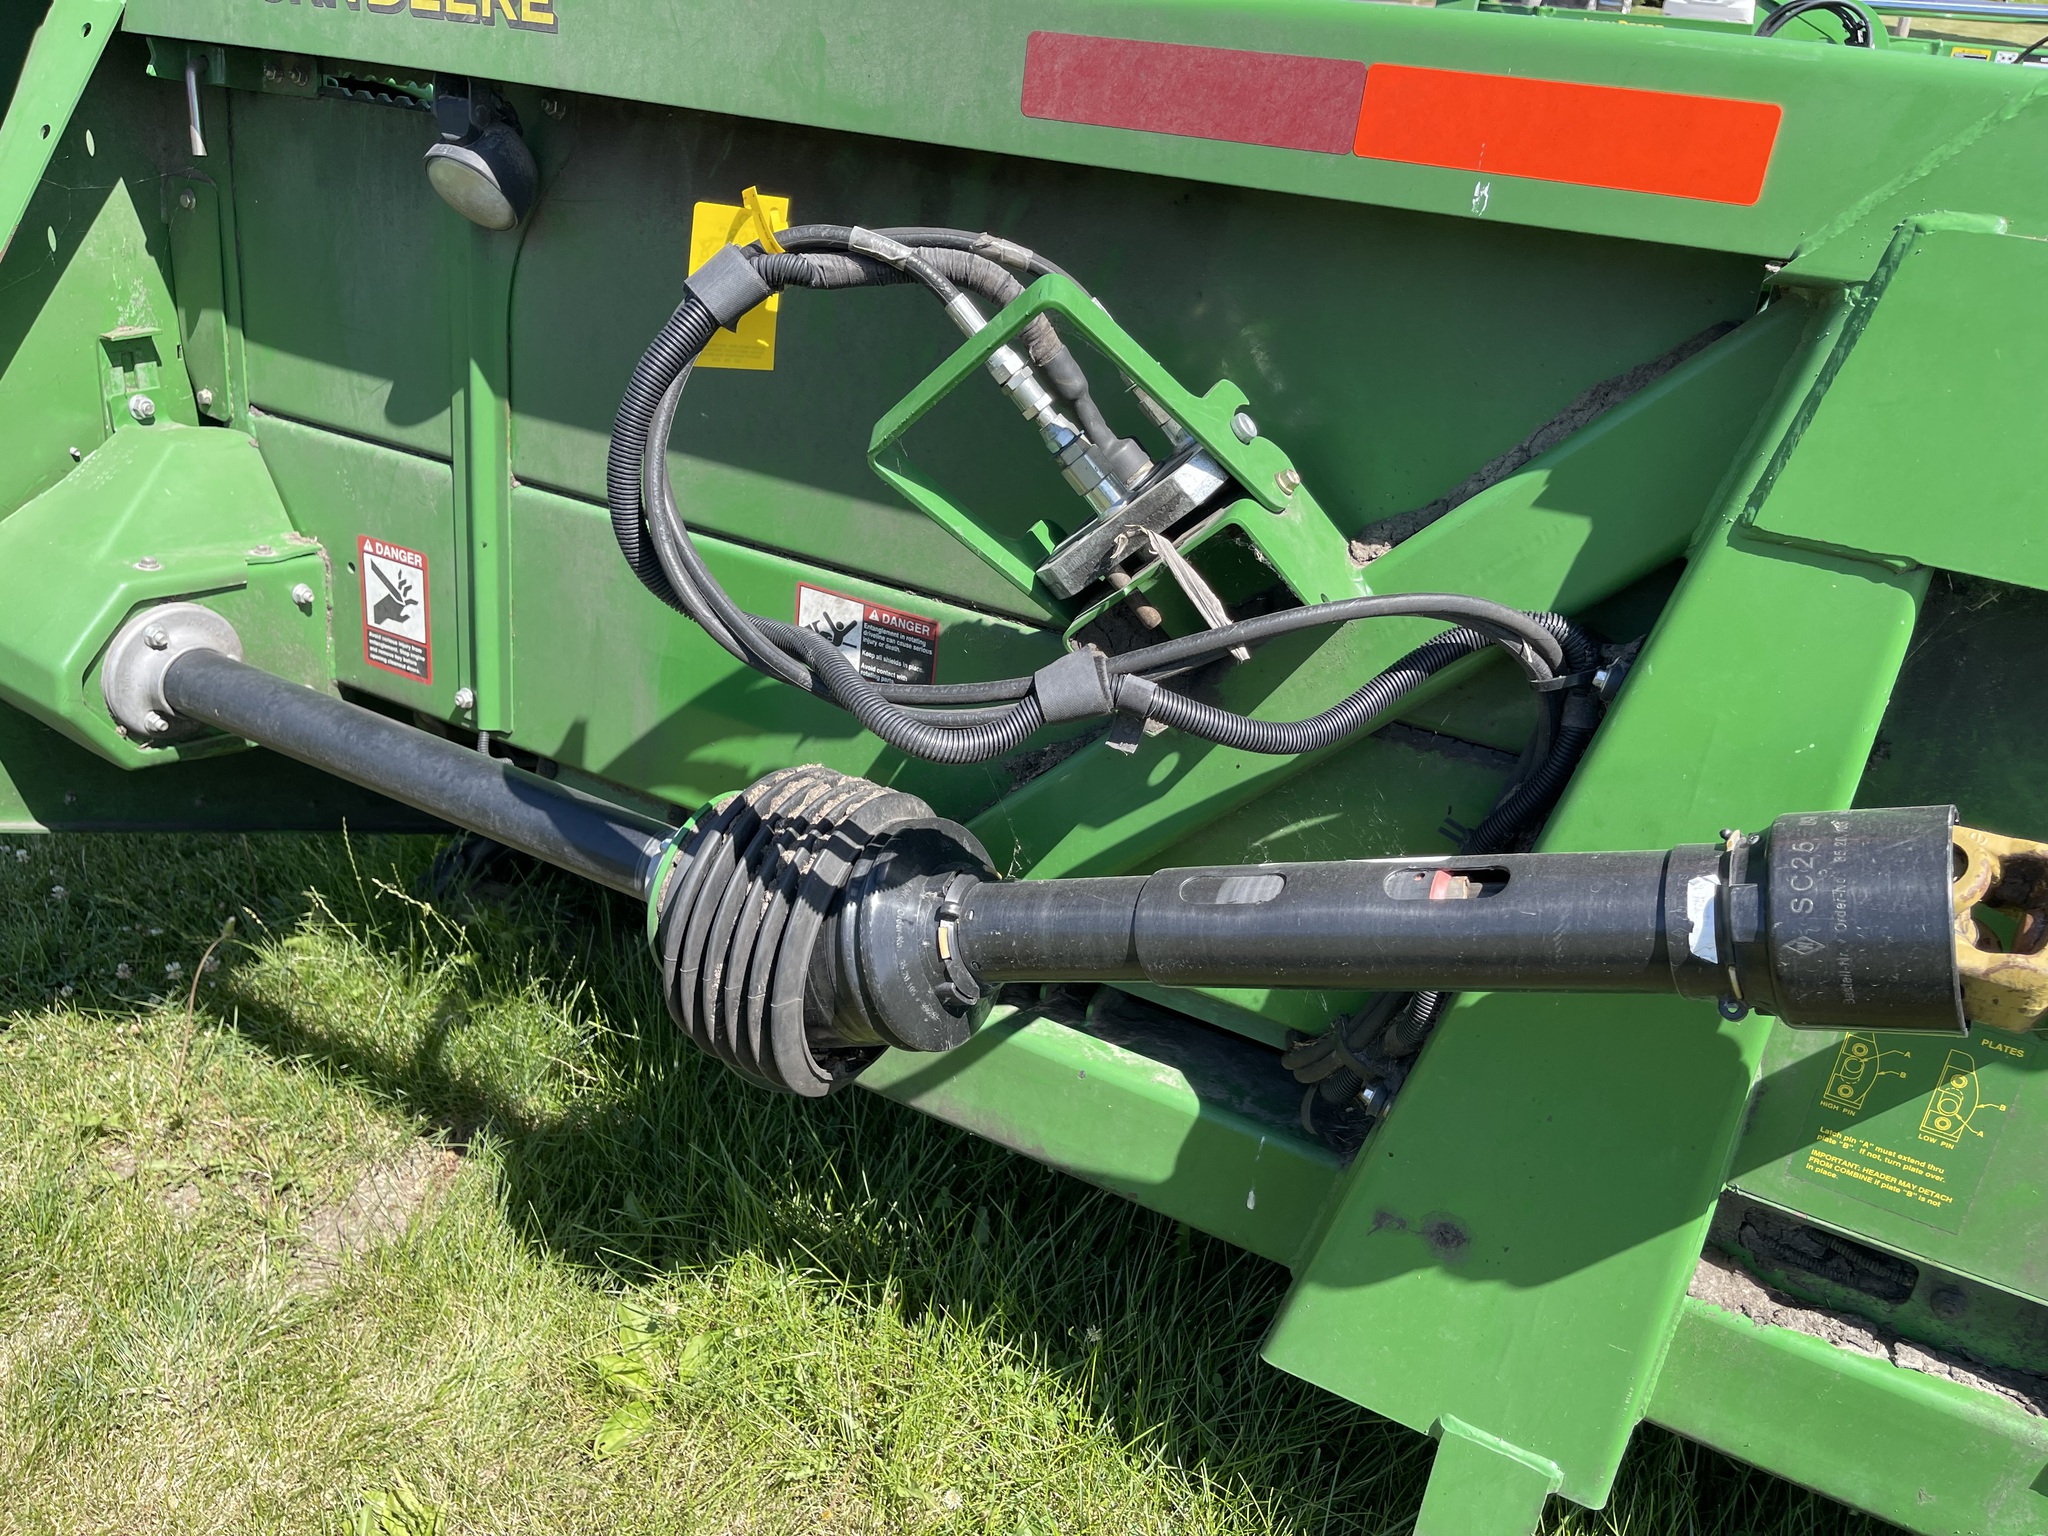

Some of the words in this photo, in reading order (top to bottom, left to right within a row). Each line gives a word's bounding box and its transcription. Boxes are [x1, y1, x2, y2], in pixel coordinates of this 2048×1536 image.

[375, 541, 423, 568] DANGER
[864, 622, 899, 639] Entanglement
[906, 636, 926, 648] rotating
[882, 613, 930, 637] DANGER
[863, 637, 877, 647] injury
[863, 630, 885, 641] driveline
[897, 640, 912, 649] cause
[913, 645, 932, 655] serious
[862, 650, 876, 659] Keep
[883, 656, 902, 666] shields
[860, 670, 880, 682] rotating
[861, 662, 876, 672] Avoid
[877, 668, 896, 678] contact
[896, 673, 908, 682] with
[1981, 1038, 2025, 1058] PLATES
[1899, 1071, 1907, 1079] B
[1819, 1100, 1839, 1111] HIGH
[1842, 1107, 1856, 1117] PIN
[1999, 1104, 2007, 1112] B
[1918, 1133, 1938, 1145] LOW
[1940, 1140, 1955, 1150] PIN
[1977, 1130, 1984, 1138] A
[1817, 1134, 1837, 1146] plate
[1859, 1148, 1866, 1156] If
[1866, 1151, 1882, 1162] not,
[1884, 1157, 1901, 1168] turn
[1902, 1163, 1924, 1176] plate
[1925, 1172, 1946, 1183] over.
[1820, 1126, 1842, 1139] Latch
[1843, 1133, 1857, 1144] pin
[1875, 1145, 1896, 1157] must
[1898, 1152, 1926, 1168] extend
[1927, 1163, 1945, 1174] thru
[1808, 1155, 1833, 1170] FROM
[1833, 1165, 1873, 1184] COMBINE
[1874, 1177, 1880, 1186] if
[1880, 1182, 1901, 1194] plate
[1918, 1194, 1926, 1202] is
[1927, 1197, 1942, 1208] not
[1810, 1148, 1861, 1172] IMPORTANT:
[1862, 1166, 1897, 1184] HEADER
[1898, 1179, 1917, 1190] MAY
[1918, 1186, 1953, 1204] DETACH
[1814, 1166, 1839, 1180] place.
